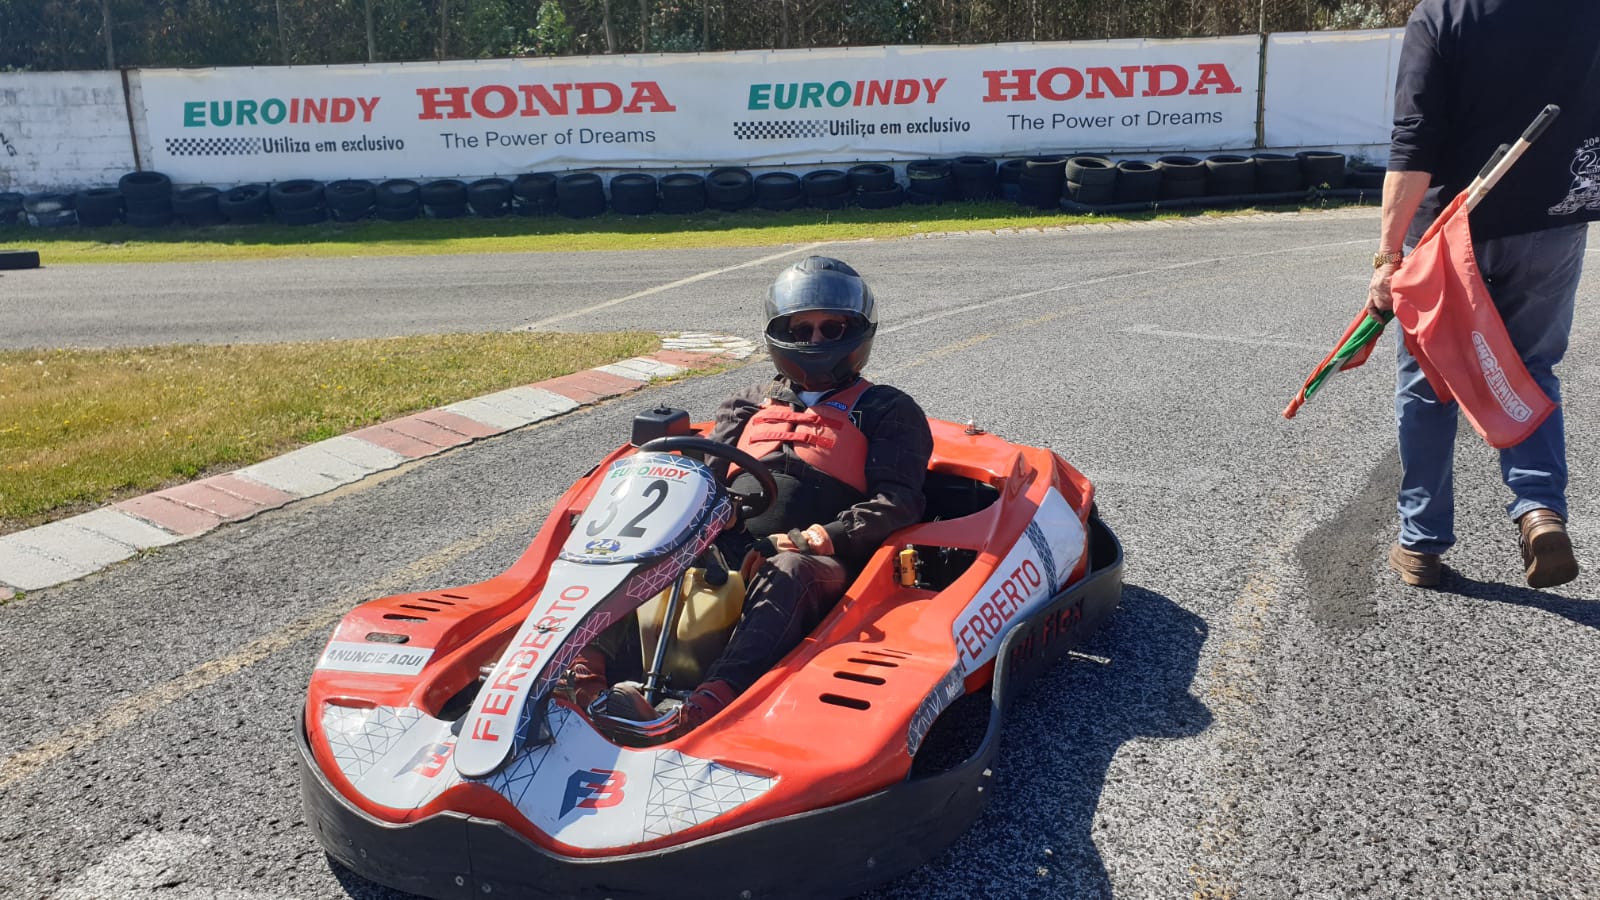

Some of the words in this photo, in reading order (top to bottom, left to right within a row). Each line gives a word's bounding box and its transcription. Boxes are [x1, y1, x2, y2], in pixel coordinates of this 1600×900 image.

[748, 78, 947, 110] EUROINDY
[983, 63, 1241, 102] HONDA
[183, 96, 381, 127] EUROINDY
[416, 81, 676, 120] HONDA
[829, 119, 875, 137] Utiliza
[880, 122, 901, 135] em
[906, 117, 970, 134] exclusivo
[1008, 114, 1044, 130] The
[1052, 113, 1115, 129] Power
[1121, 112, 1140, 127] of
[1147, 110, 1222, 126] Dreams
[262, 136, 310, 153] Utiliza
[316, 140, 336, 152] em
[341, 135, 404, 152] exclusivo
[440, 132, 478, 149] The
[486, 131, 548, 147] Power
[555, 129, 573, 145] of
[580, 128, 656, 144] Dreams
[954, 558, 1042, 672] FERBERTO
[327, 649, 388, 664] ANUNCIE
[386, 653, 425, 667] AQUI
[472, 585, 590, 742] FERBERTO
